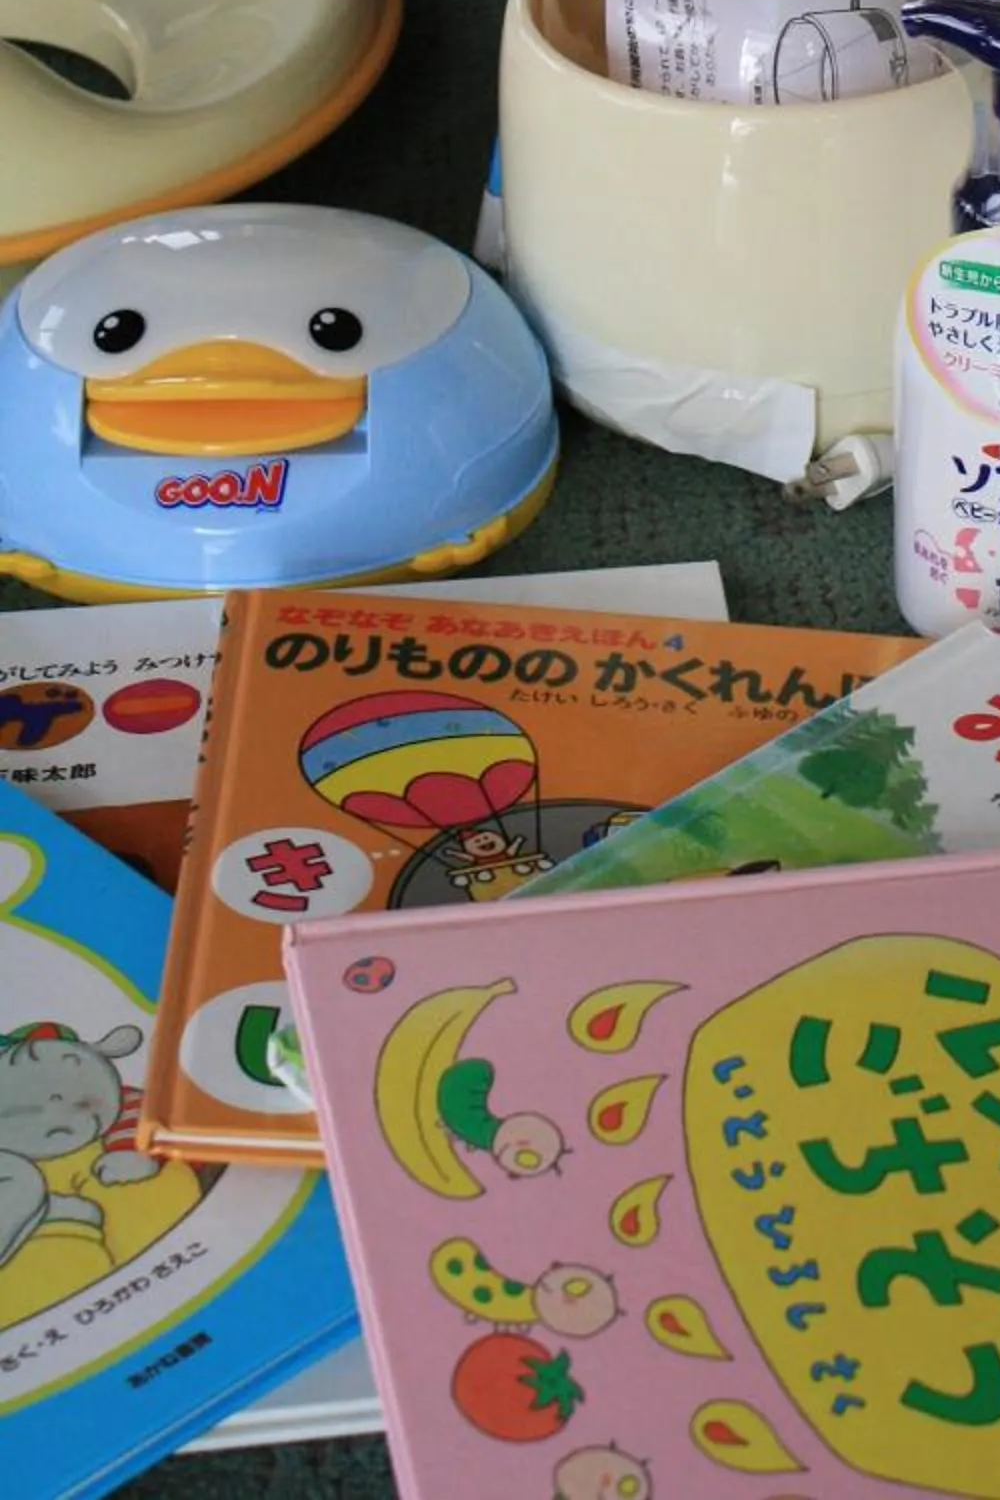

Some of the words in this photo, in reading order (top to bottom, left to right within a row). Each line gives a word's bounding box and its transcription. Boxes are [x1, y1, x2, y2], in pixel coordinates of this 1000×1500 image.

[276, 605, 415, 632] なぞなぞ
[425, 612, 657, 651] あなあきえほん
[662, 633, 687, 652] 4
[265, 632, 579, 688] のりものの
